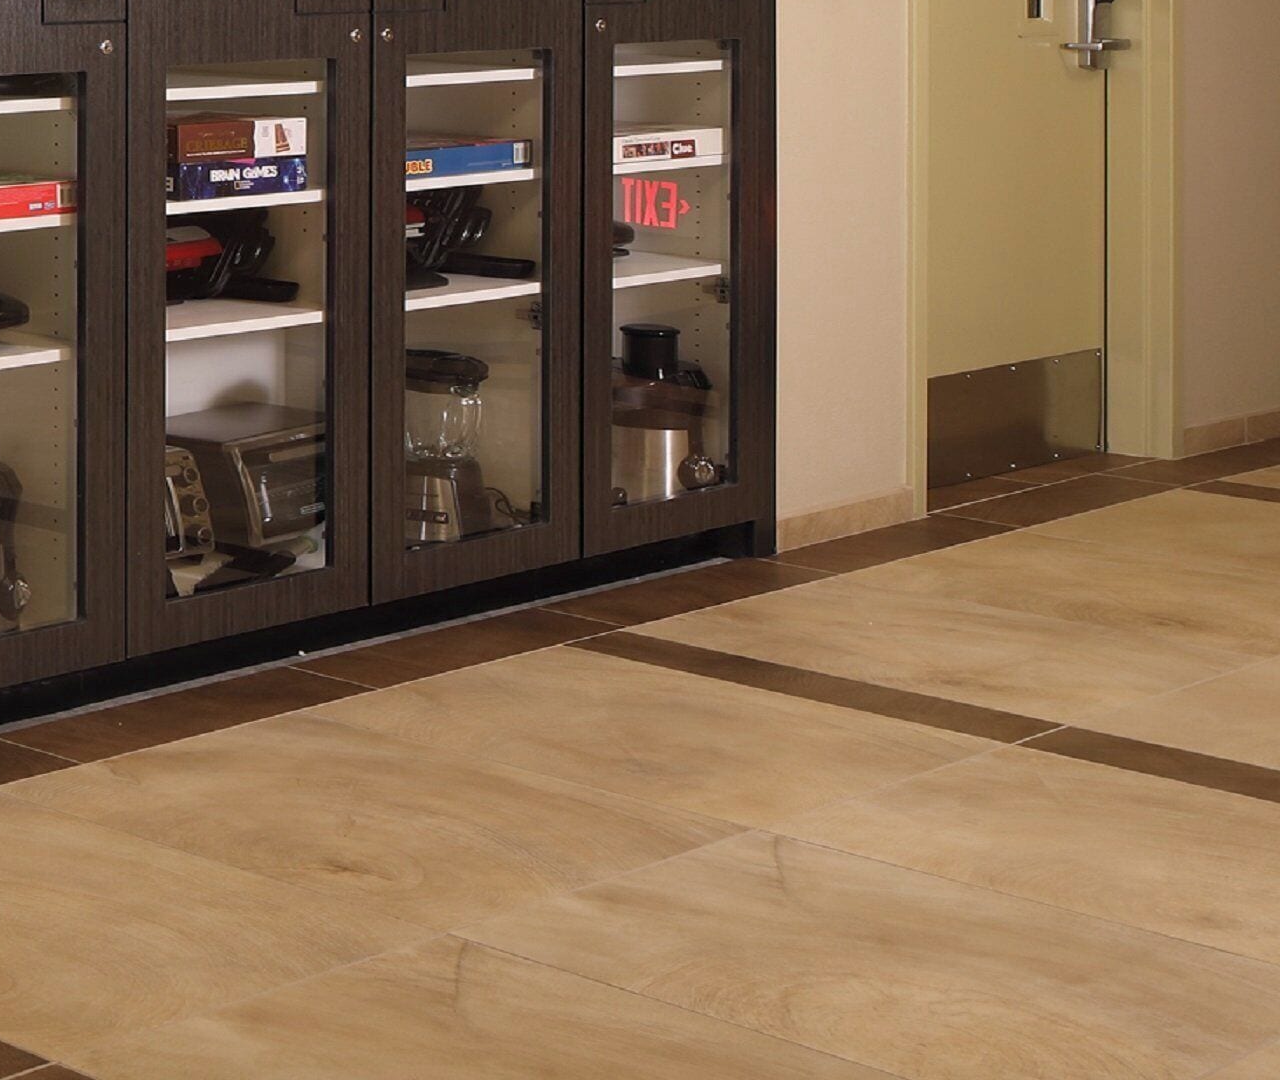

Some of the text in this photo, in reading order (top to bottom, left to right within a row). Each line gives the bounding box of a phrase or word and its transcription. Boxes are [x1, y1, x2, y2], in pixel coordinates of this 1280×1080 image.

[186, 137, 248, 151] CRIBBAGE
[209, 168, 241, 182] BRAIN
[242, 165, 279, 180] GAMES
